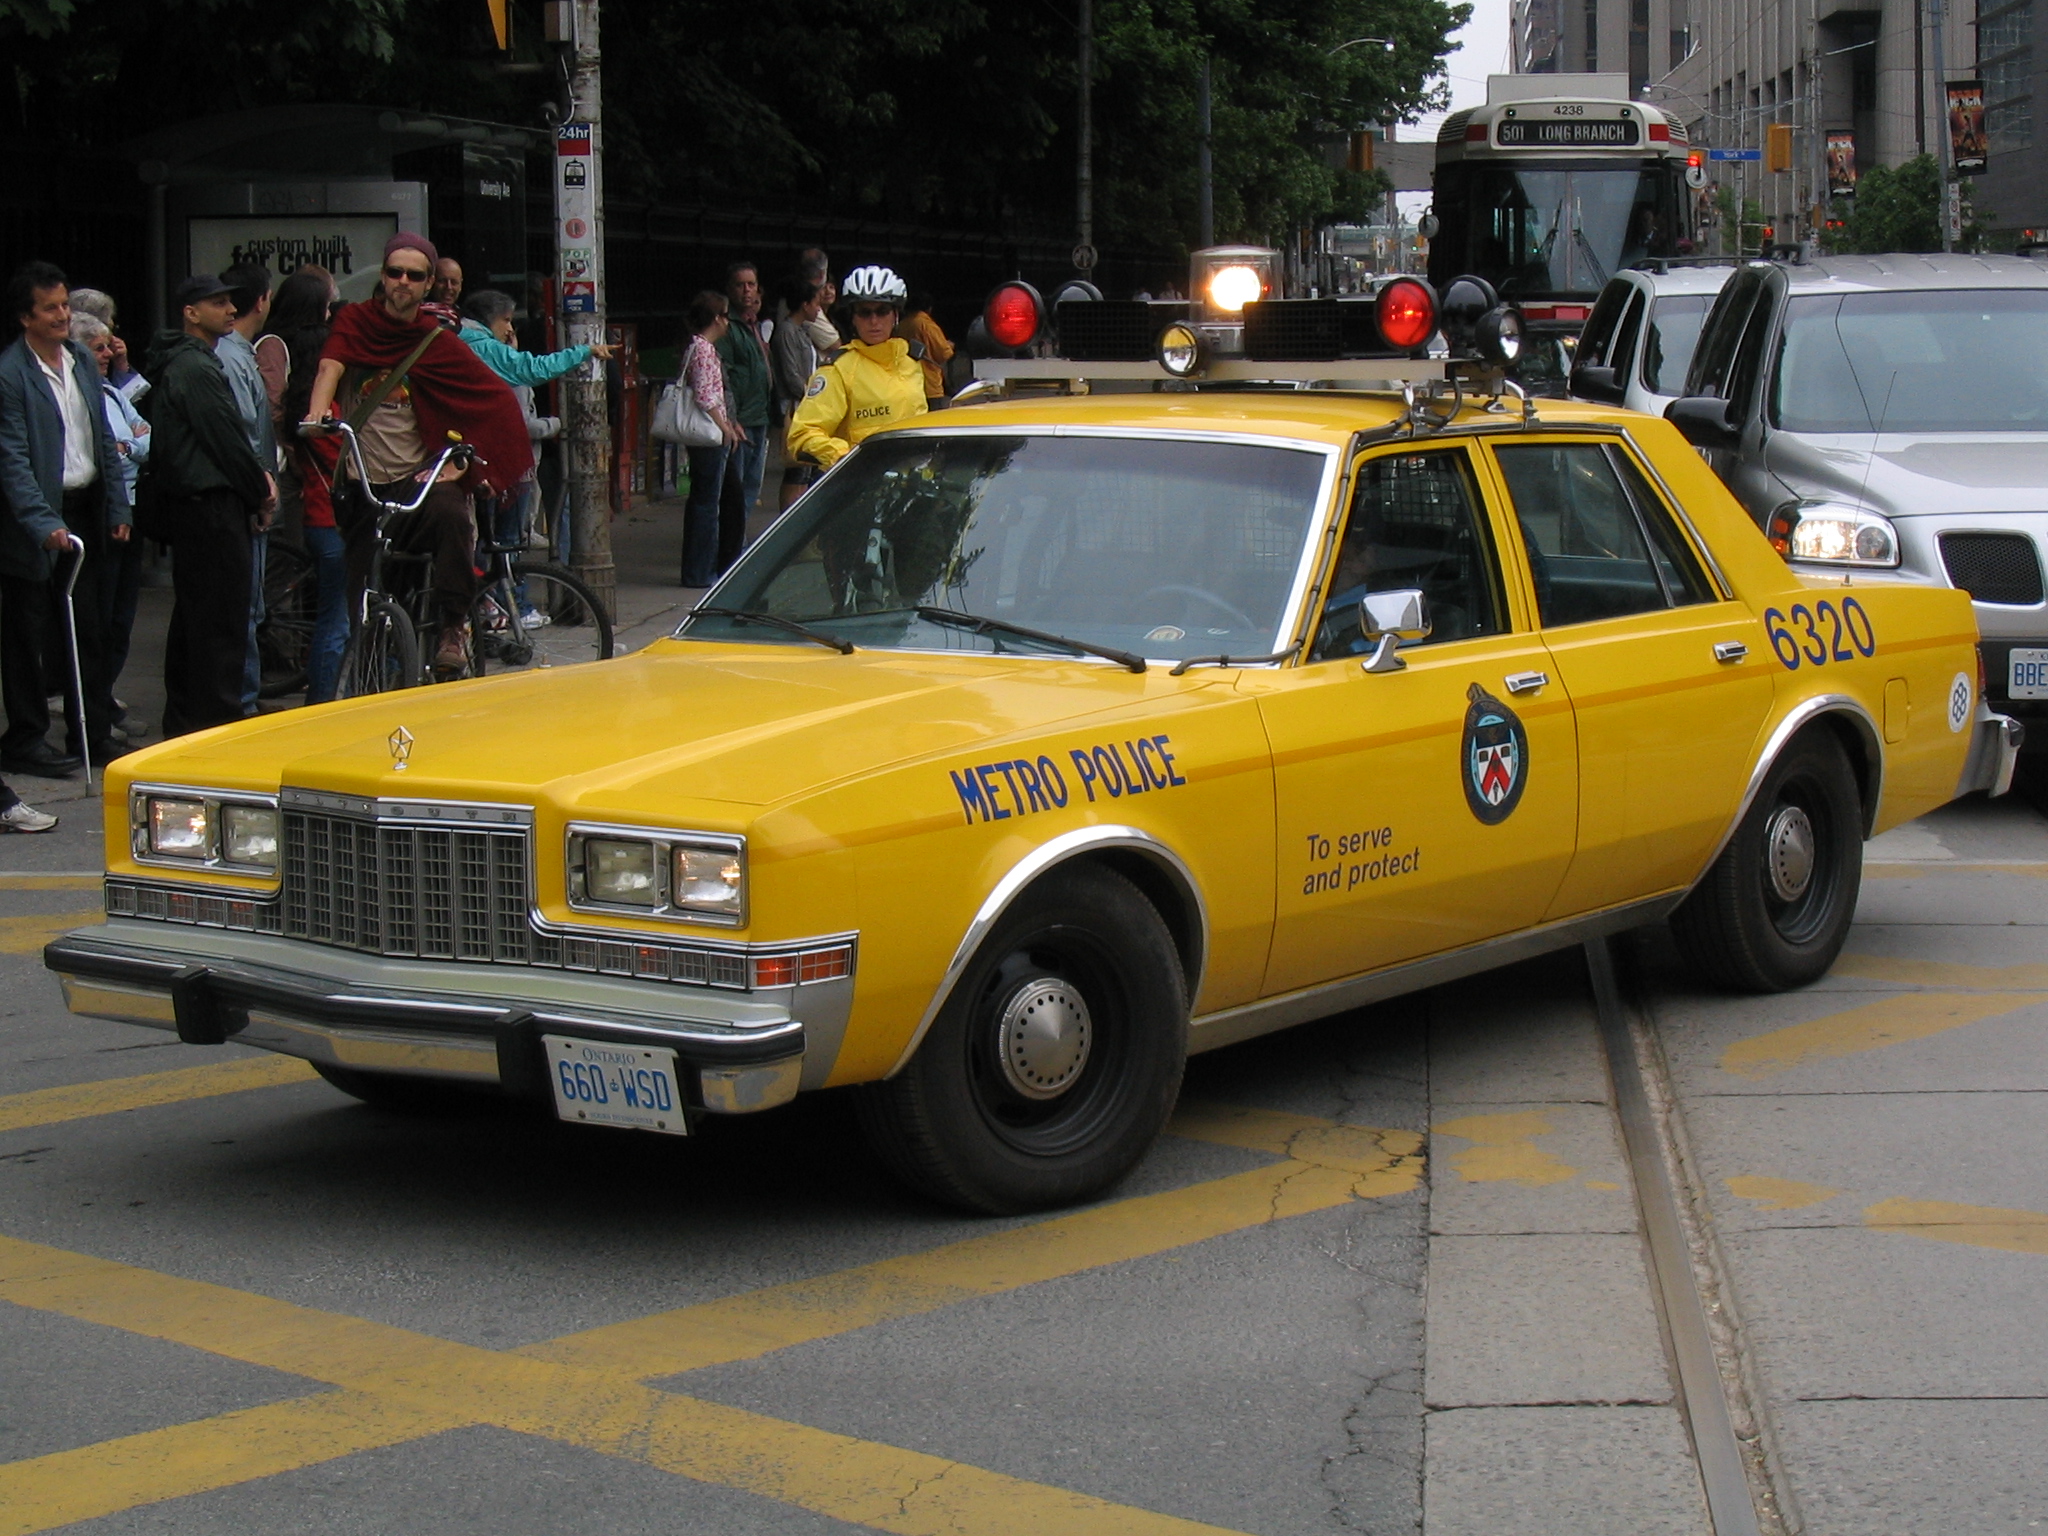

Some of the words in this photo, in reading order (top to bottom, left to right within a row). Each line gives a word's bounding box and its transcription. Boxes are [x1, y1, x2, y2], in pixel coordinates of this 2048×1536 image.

[1553, 105, 1584, 116] 4238
[558, 126, 590, 140] 24hr
[1502, 123, 1525, 142] 501
[1538, 123, 1571, 143] LONG
[1573, 123, 1626, 142] BRANCH
[248, 236, 307, 254] custom
[312, 235, 348, 253] built
[855, 405, 891, 419] POLICE
[1764, 596, 1875, 671] 6320
[949, 755, 1069, 825] METRO
[1069, 734, 1187, 802] POLICE
[1307, 834, 1330, 862] To
[1338, 826, 1393, 856] serve
[1302, 862, 1341, 895] and
[1347, 846, 1420, 891] protect
[558, 1060, 609, 1104] 660
[618, 1067, 672, 1112] WSD
